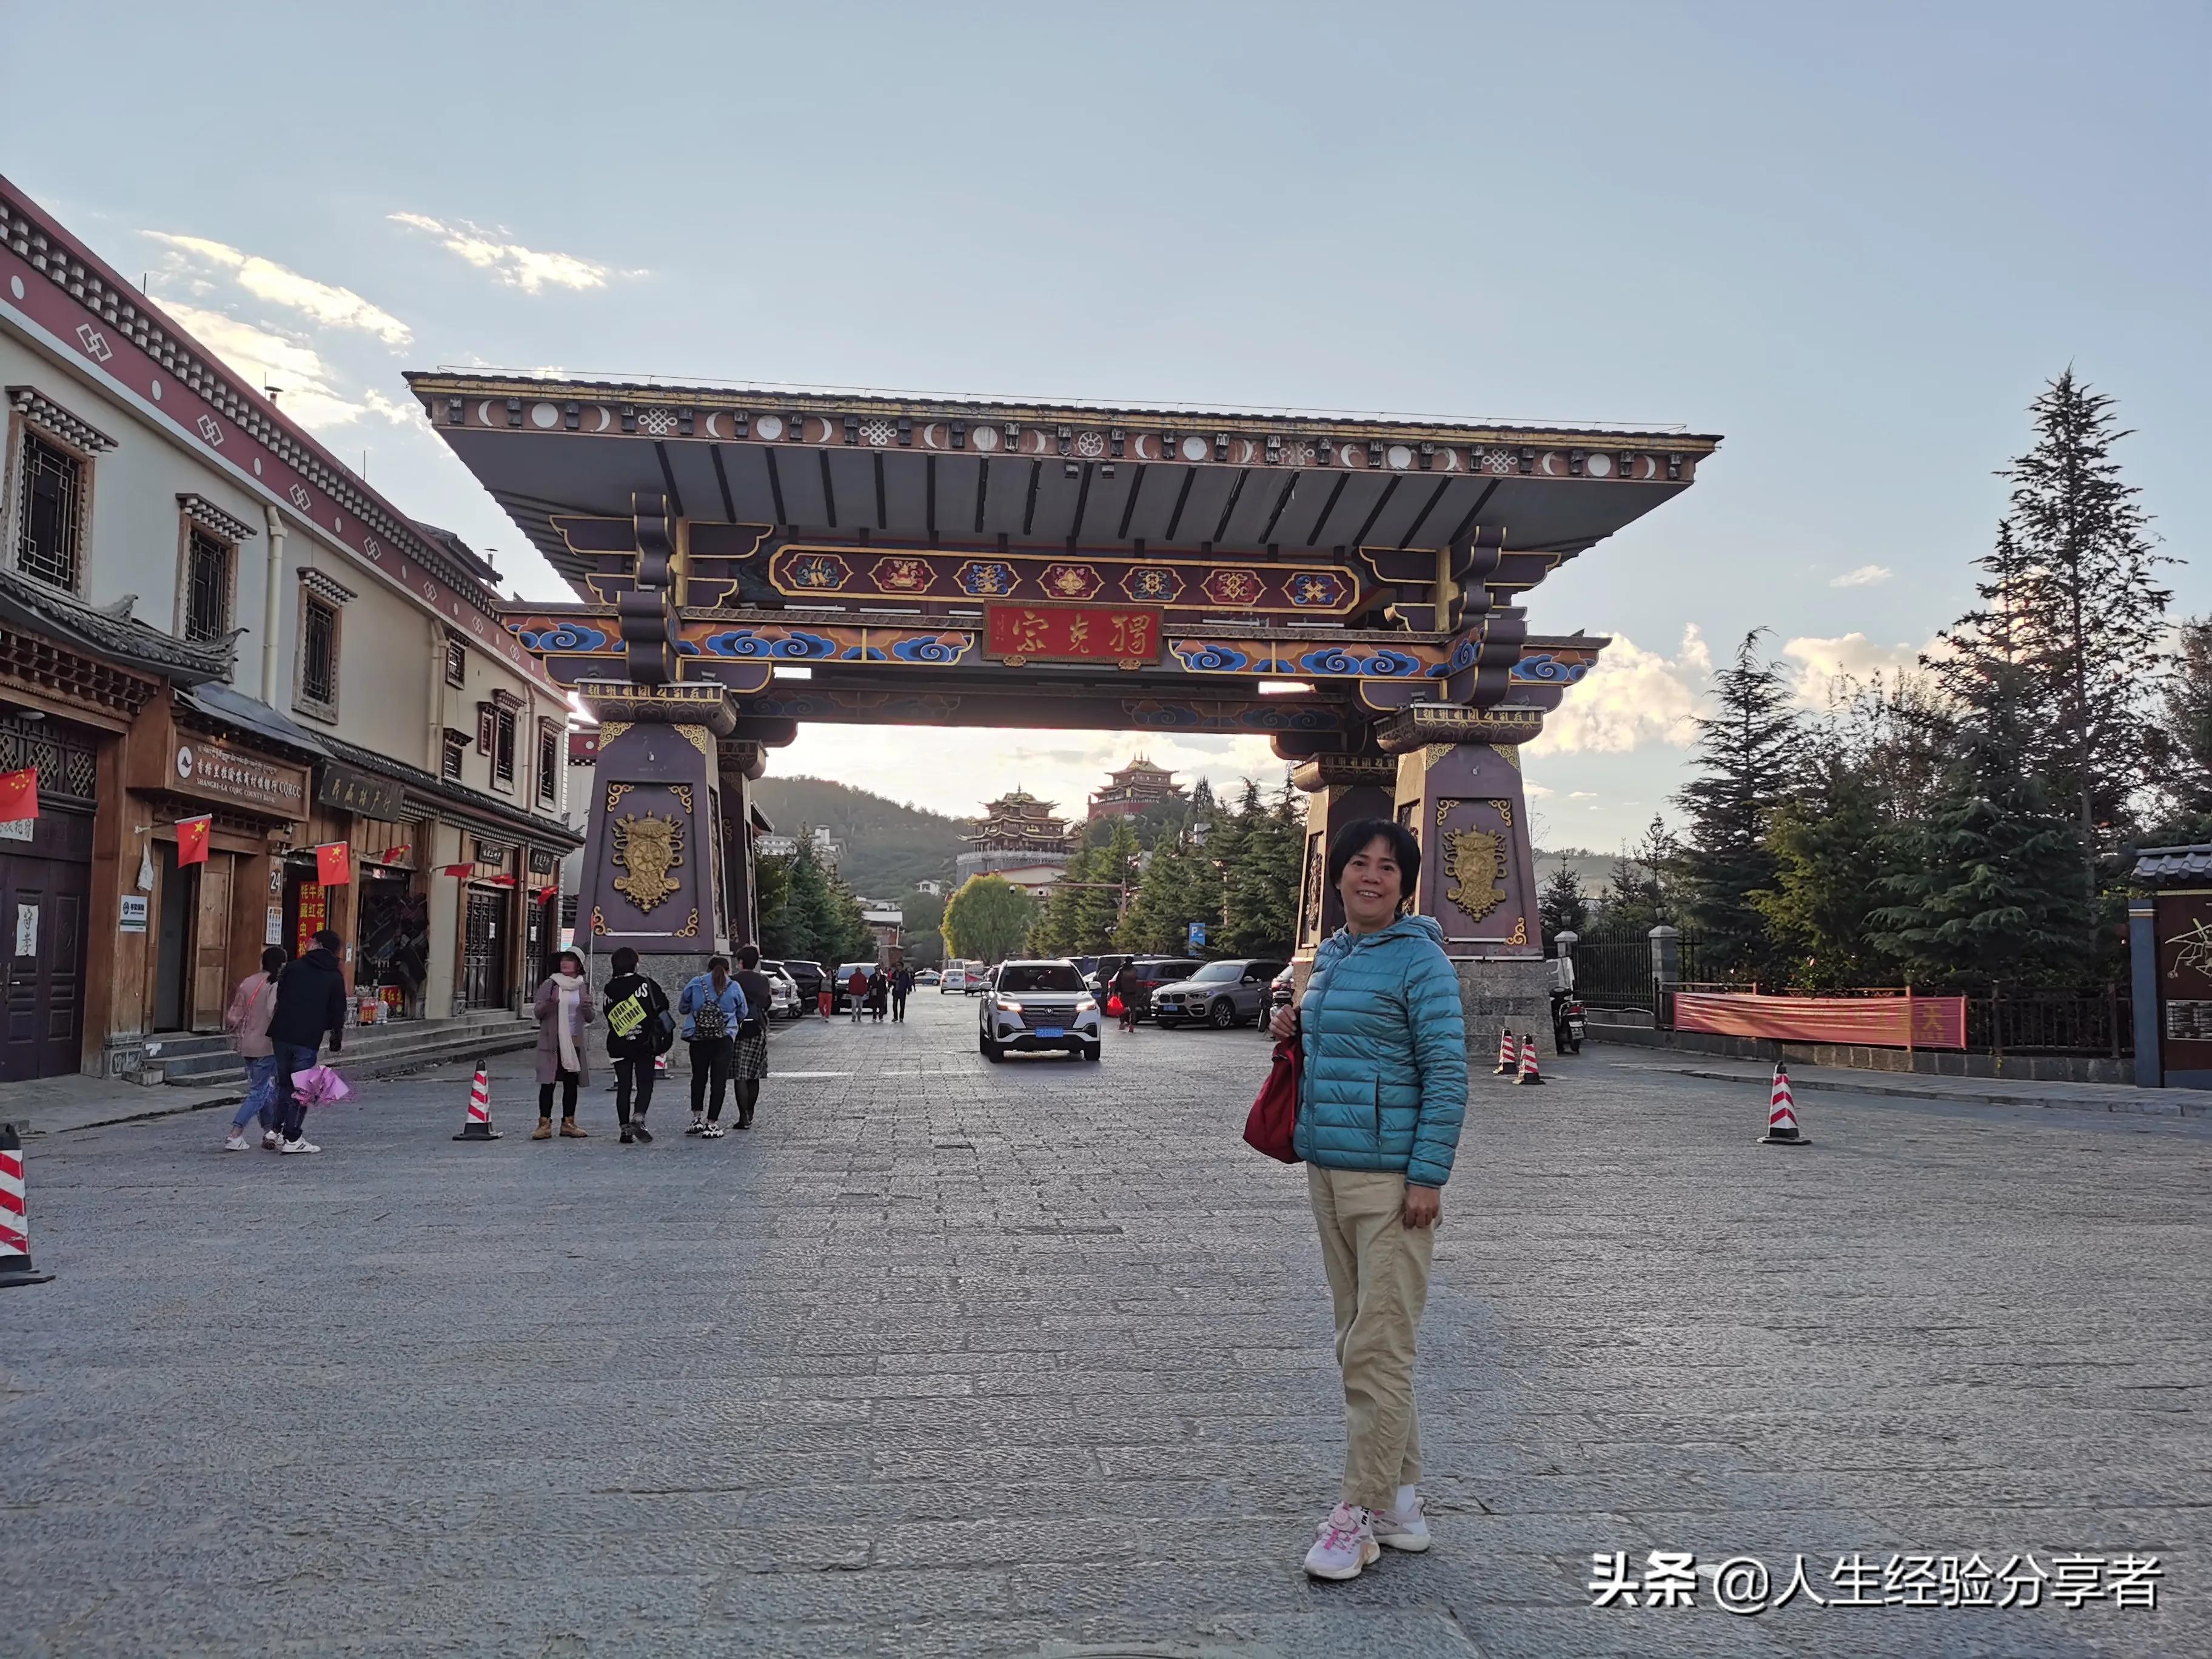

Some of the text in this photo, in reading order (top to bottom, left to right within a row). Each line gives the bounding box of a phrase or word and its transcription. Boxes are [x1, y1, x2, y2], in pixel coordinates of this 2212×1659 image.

[244, 789, 263, 801] COUNTY
[279, 781, 302, 799] CQRCC
[270, 871, 281, 893] 24
[300, 903, 326, 919] 藏红花
